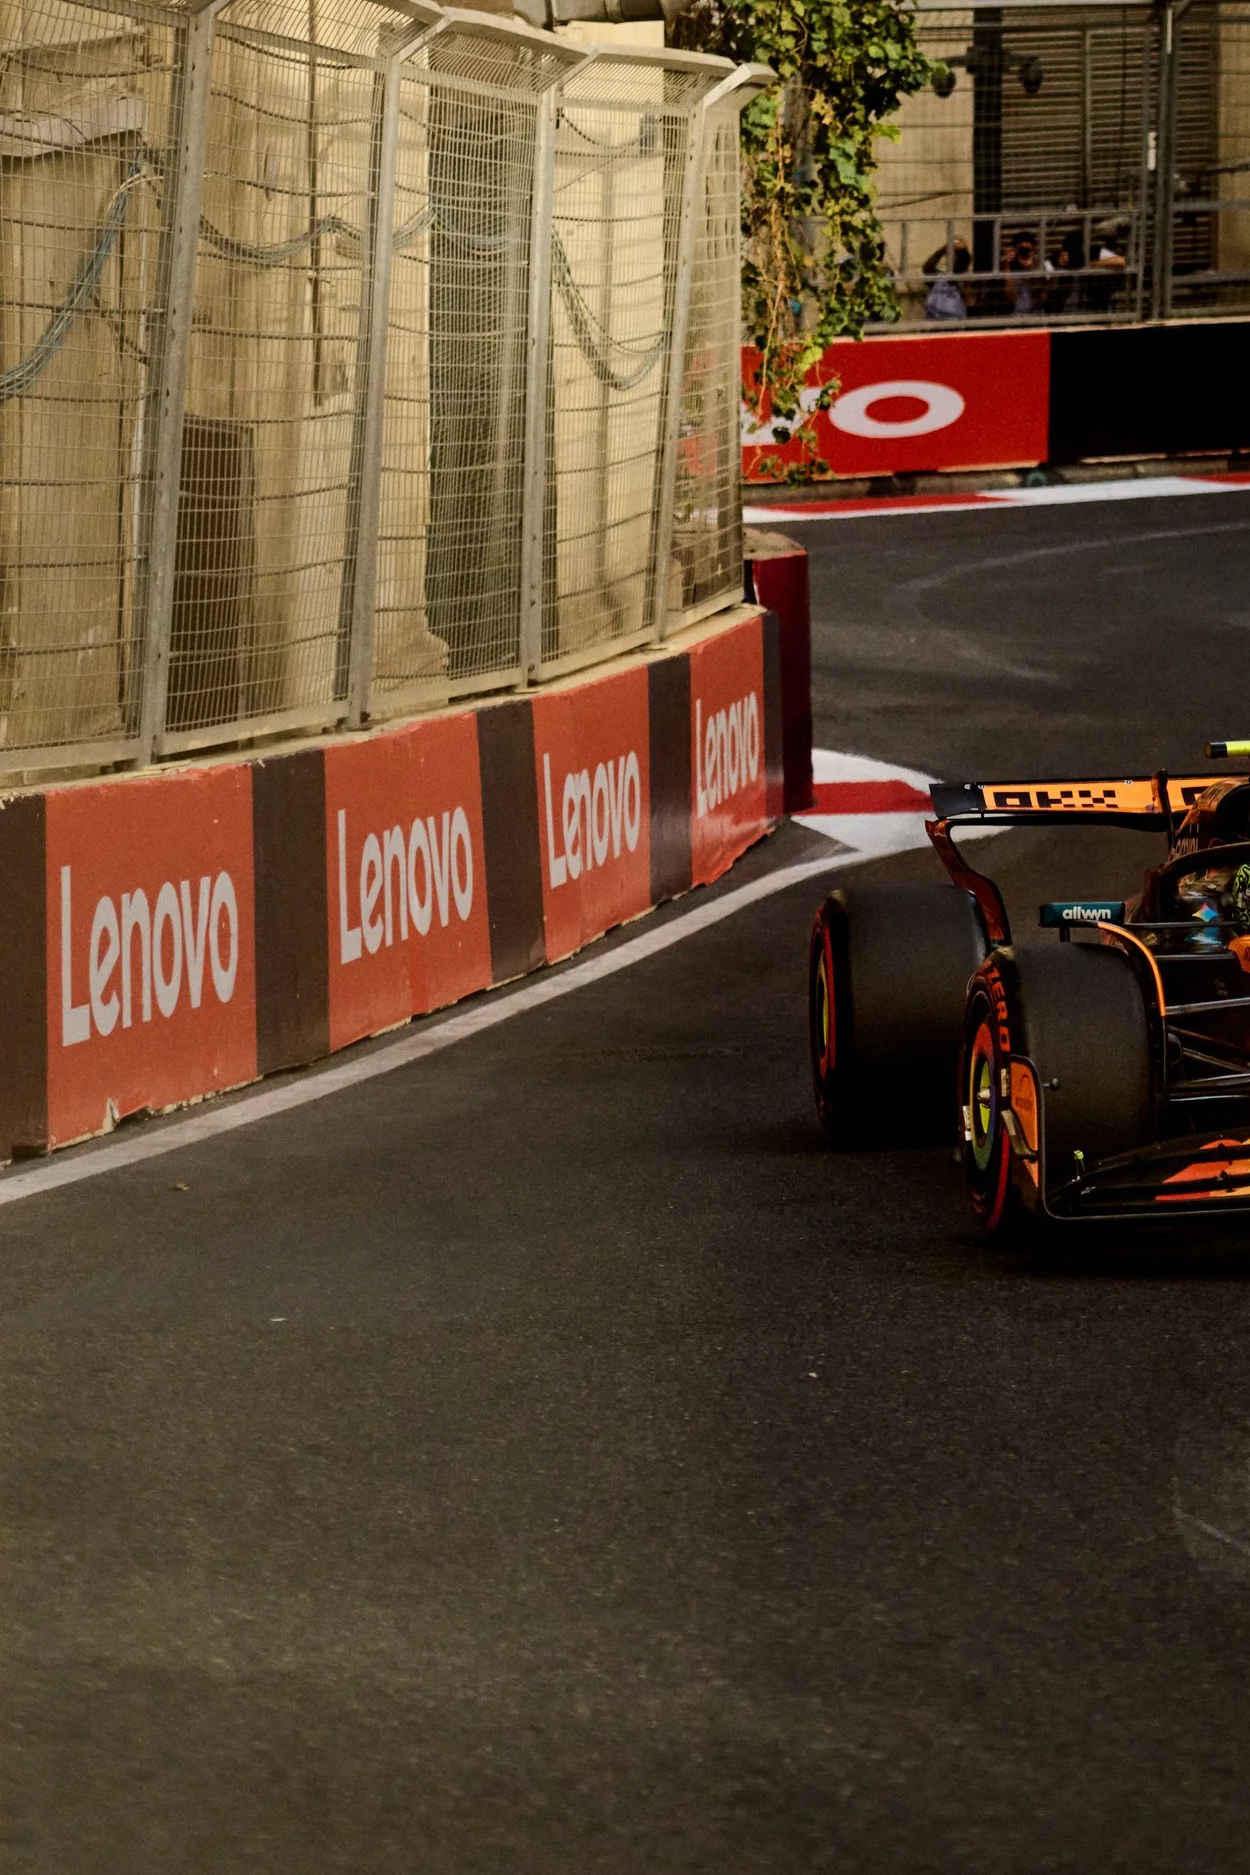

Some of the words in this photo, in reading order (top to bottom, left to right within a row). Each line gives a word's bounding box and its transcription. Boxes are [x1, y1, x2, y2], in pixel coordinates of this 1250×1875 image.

[543, 748, 642, 889] Lenovo
[695, 689, 760, 818] Lenovo
[60, 864, 240, 1047] Lenovo
[337, 806, 473, 965] Lenovo
[1062, 905, 1112, 921] allwyn
